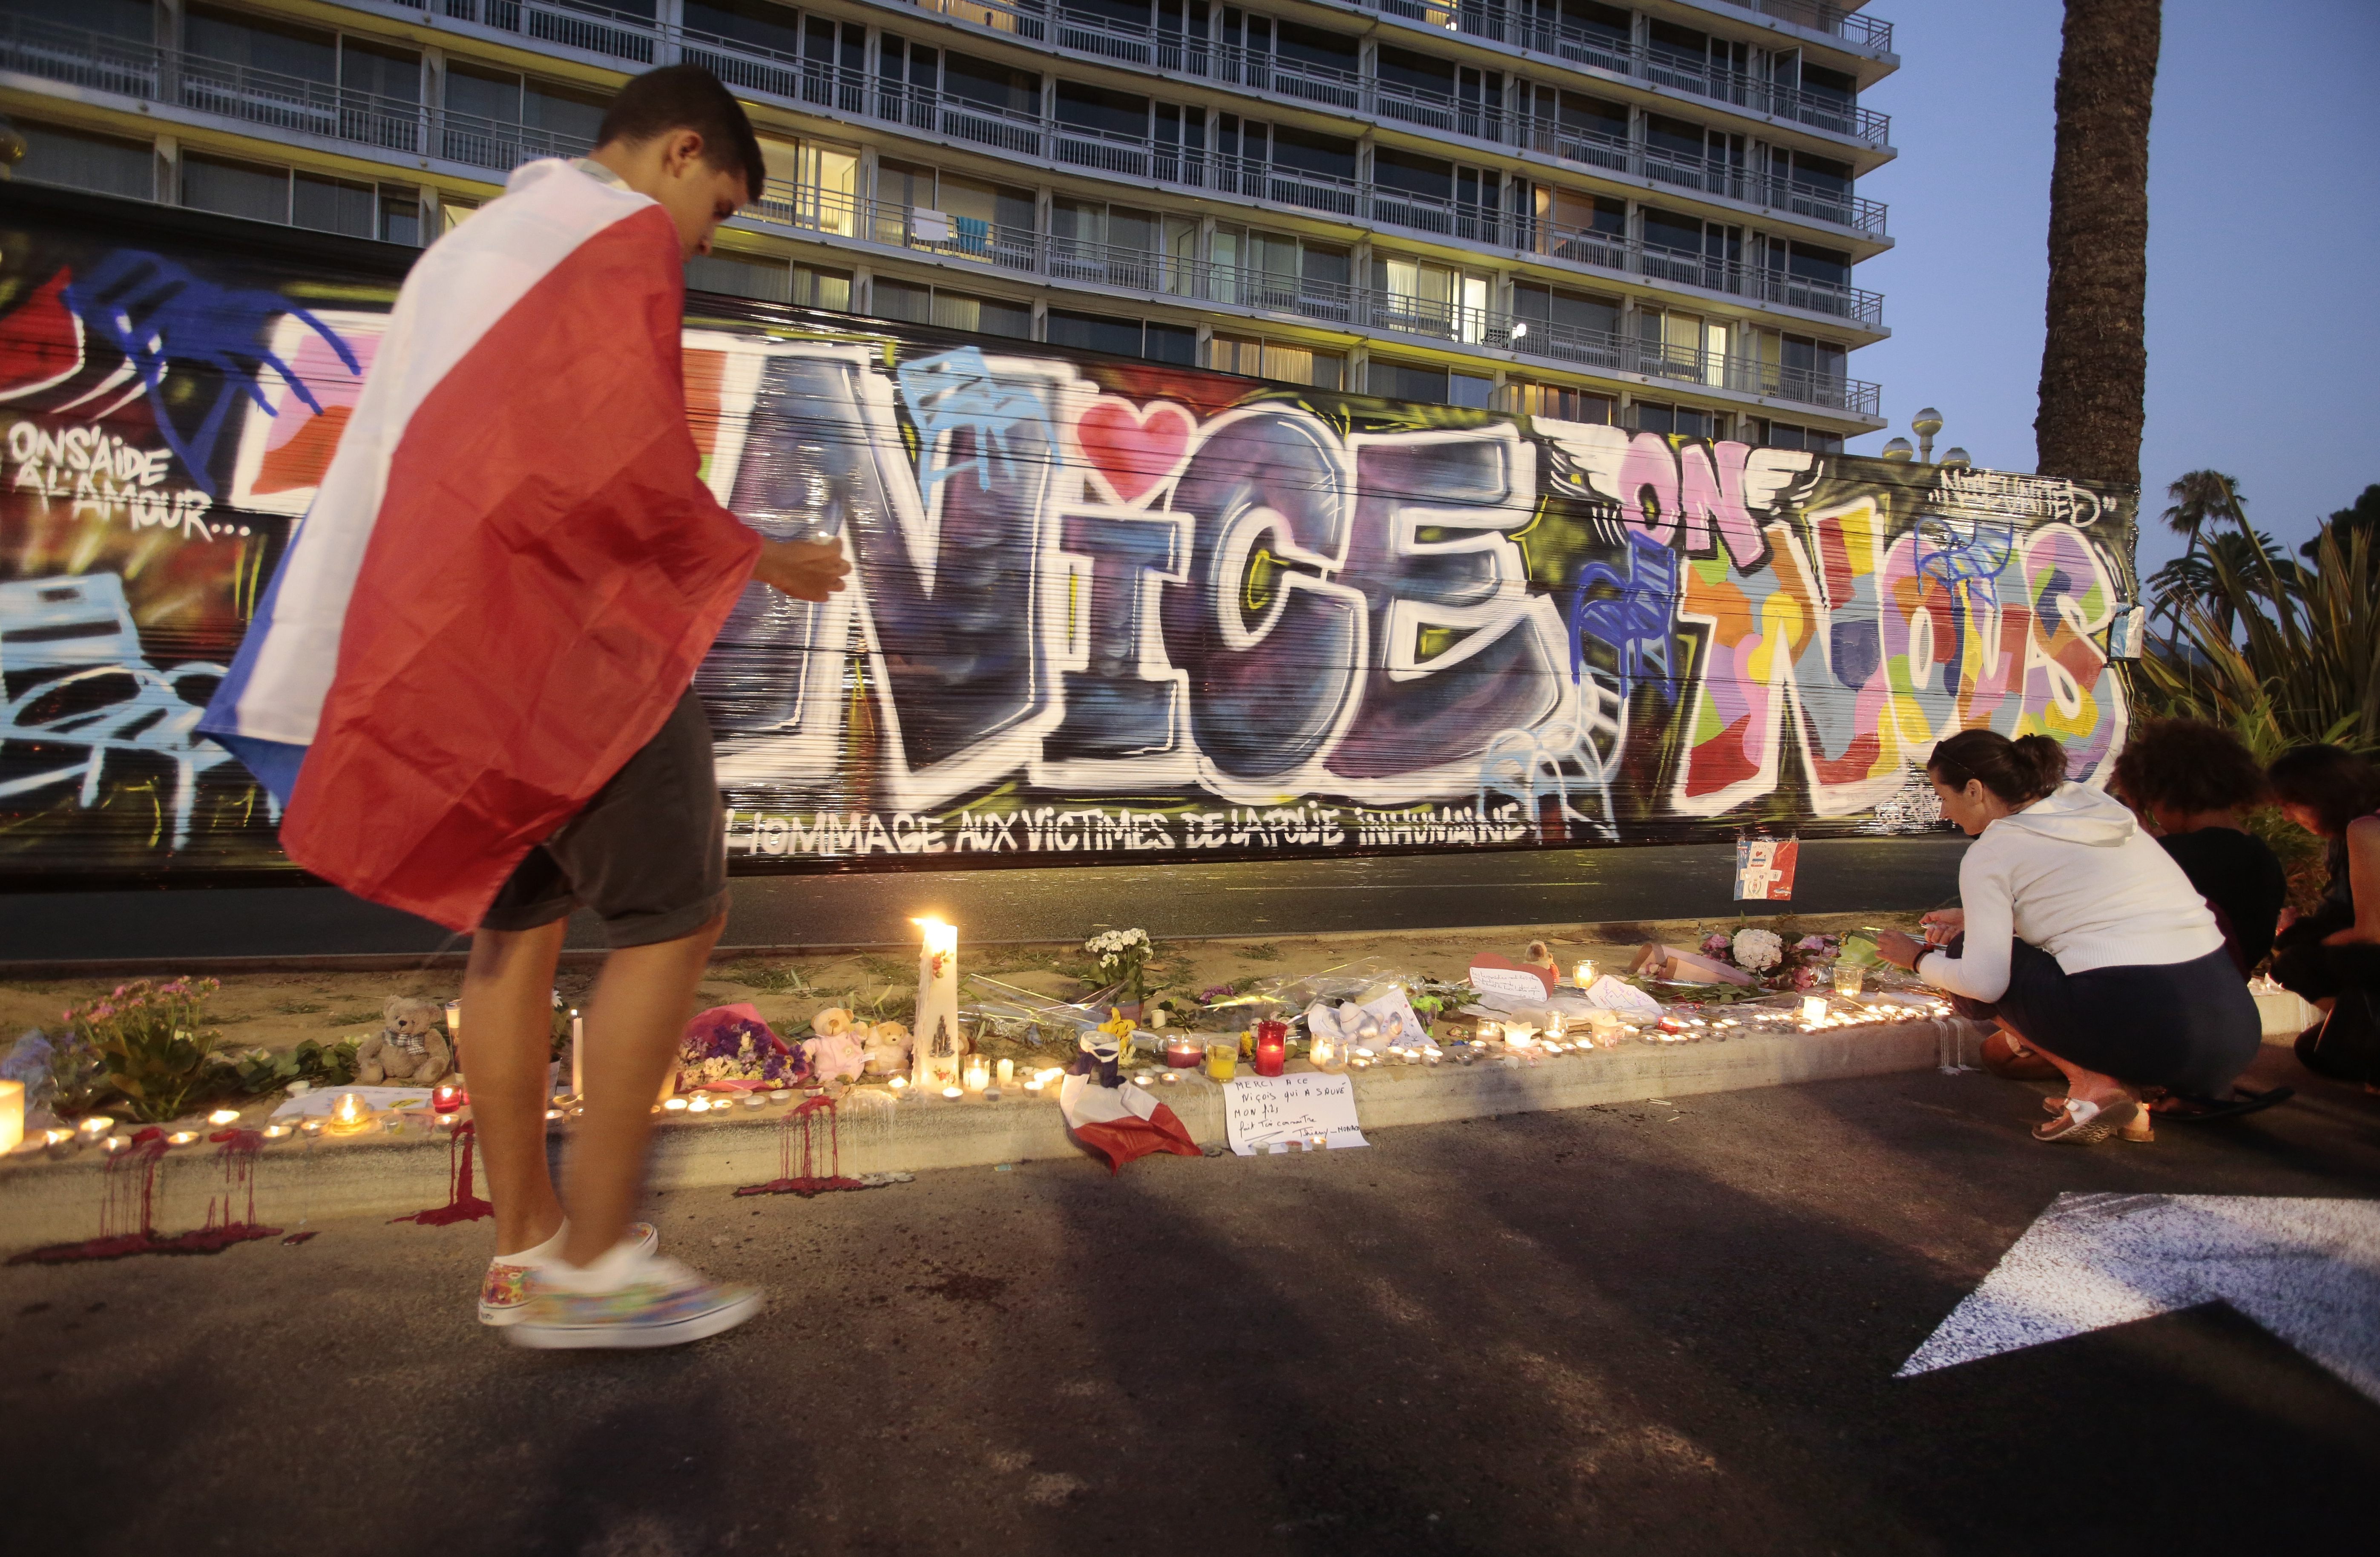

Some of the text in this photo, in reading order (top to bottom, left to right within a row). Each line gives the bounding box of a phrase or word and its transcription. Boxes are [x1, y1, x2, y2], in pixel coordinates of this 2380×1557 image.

[698, 343, 1577, 813] NICE
[1670, 497, 2129, 818] NOUS
[724, 808, 947, 857] HOMMAGE
[954, 810, 1018, 852] AUX
[1180, 812, 1227, 848] DE
[1234, 1108, 1256, 1119] MON
[1316, 1082, 1346, 1097] SAUVÉ
